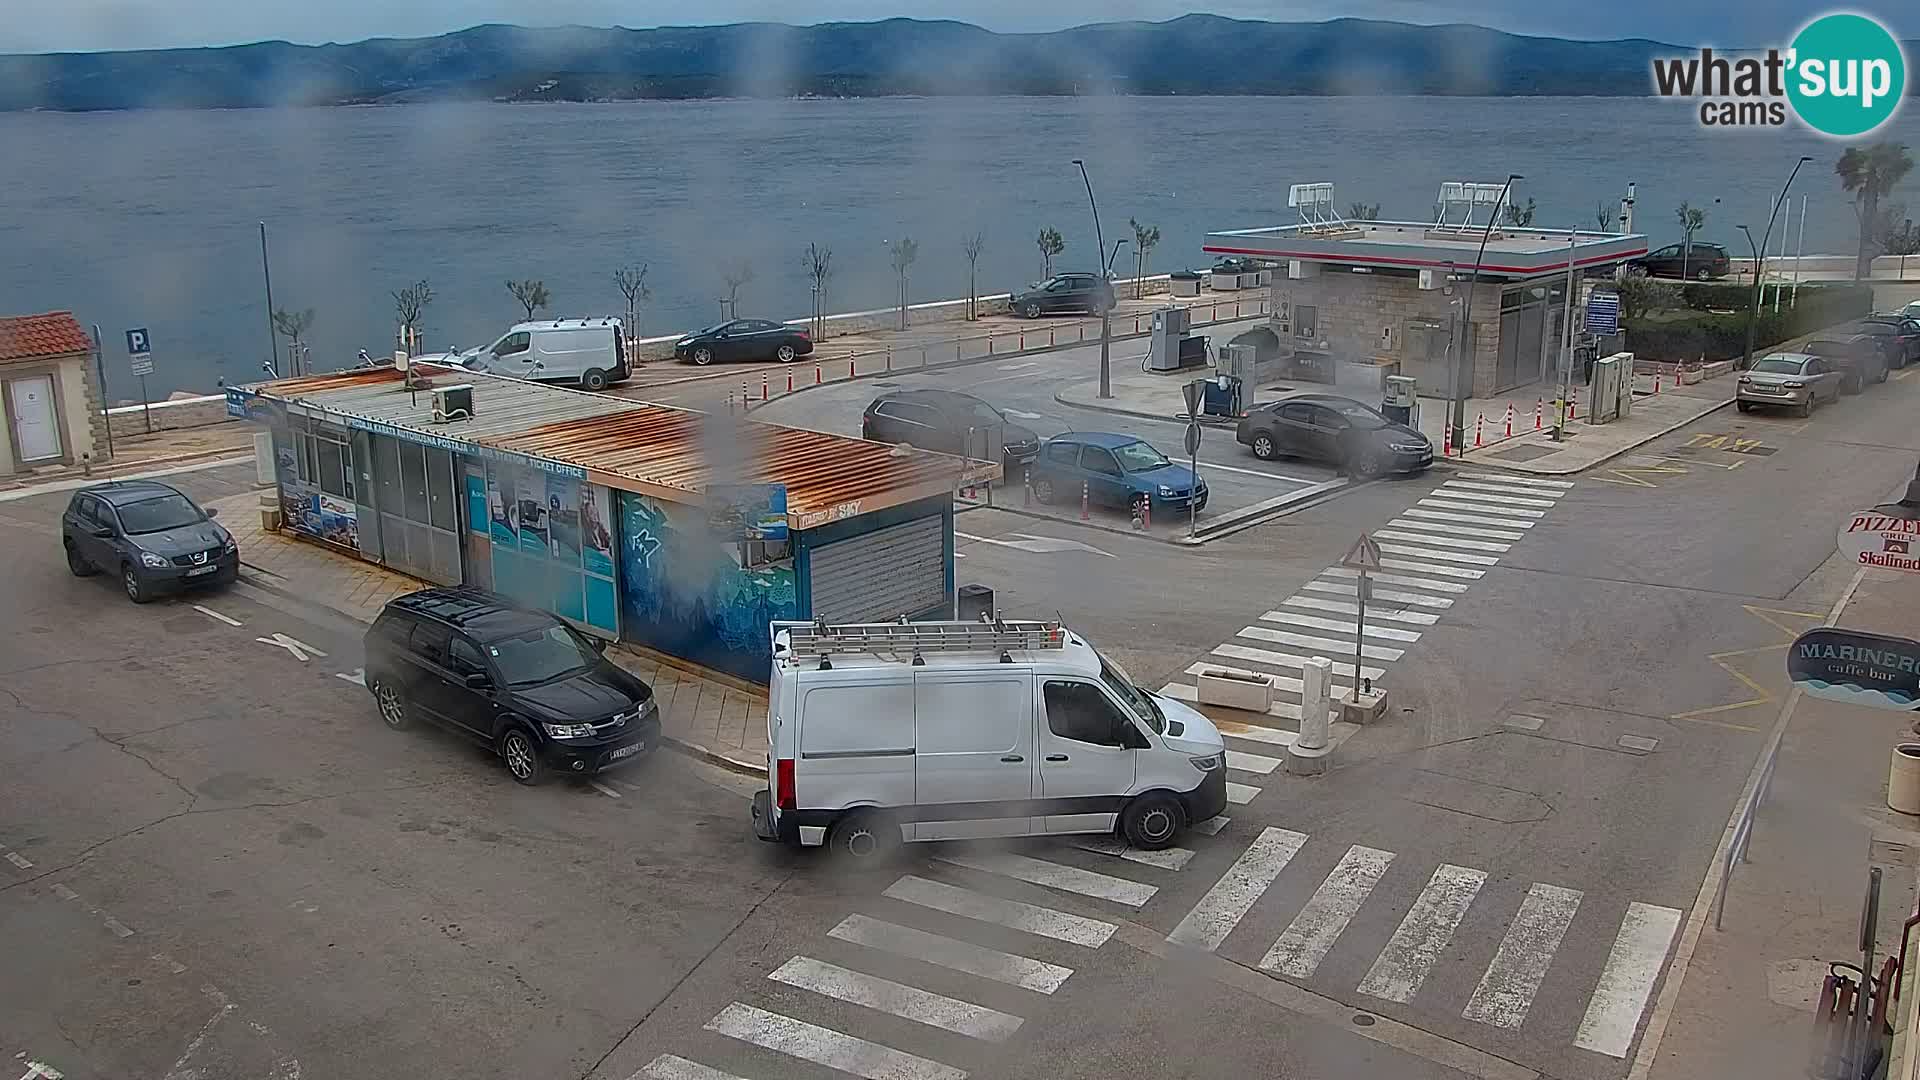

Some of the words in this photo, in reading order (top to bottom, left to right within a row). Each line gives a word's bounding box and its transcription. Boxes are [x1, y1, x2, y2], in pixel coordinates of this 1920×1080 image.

[1681, 433, 1763, 453] TAXI
[529, 458, 555, 473] TICKET
[556, 464, 583, 479] OFFICE
[1881, 532, 1917, 543] GRILL
[1828, 663, 1864, 677] caffe
[1869, 667, 1896, 681] bar
